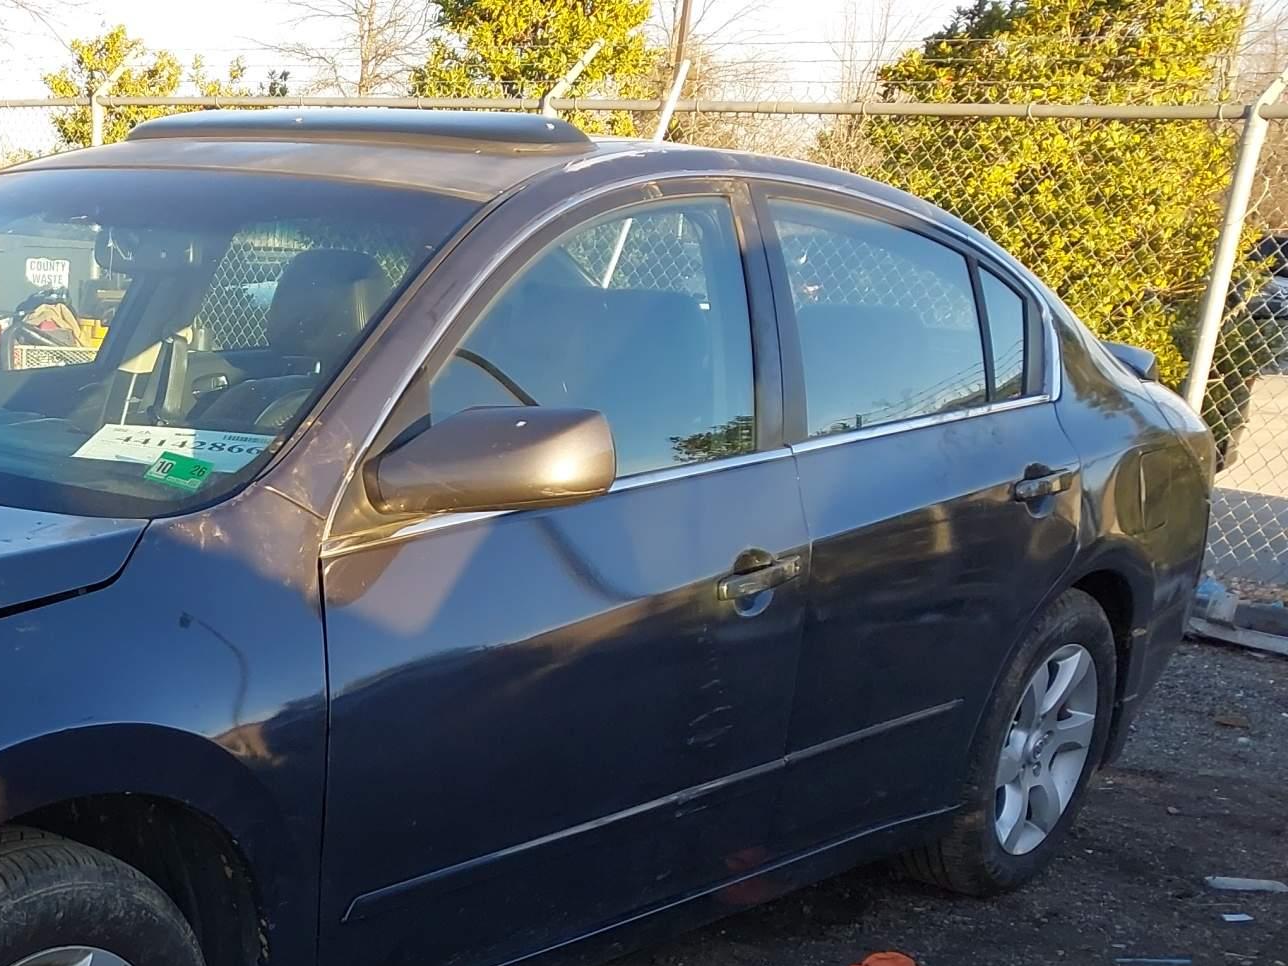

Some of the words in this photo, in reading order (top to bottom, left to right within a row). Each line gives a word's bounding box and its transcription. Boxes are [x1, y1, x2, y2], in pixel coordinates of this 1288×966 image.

[29, 260, 66, 271] COUNTY
[32, 273, 63, 285] WASTE
[115, 436, 264, 455] 44142866
[156, 460, 174, 474] 10
[190, 464, 208, 477] 26
